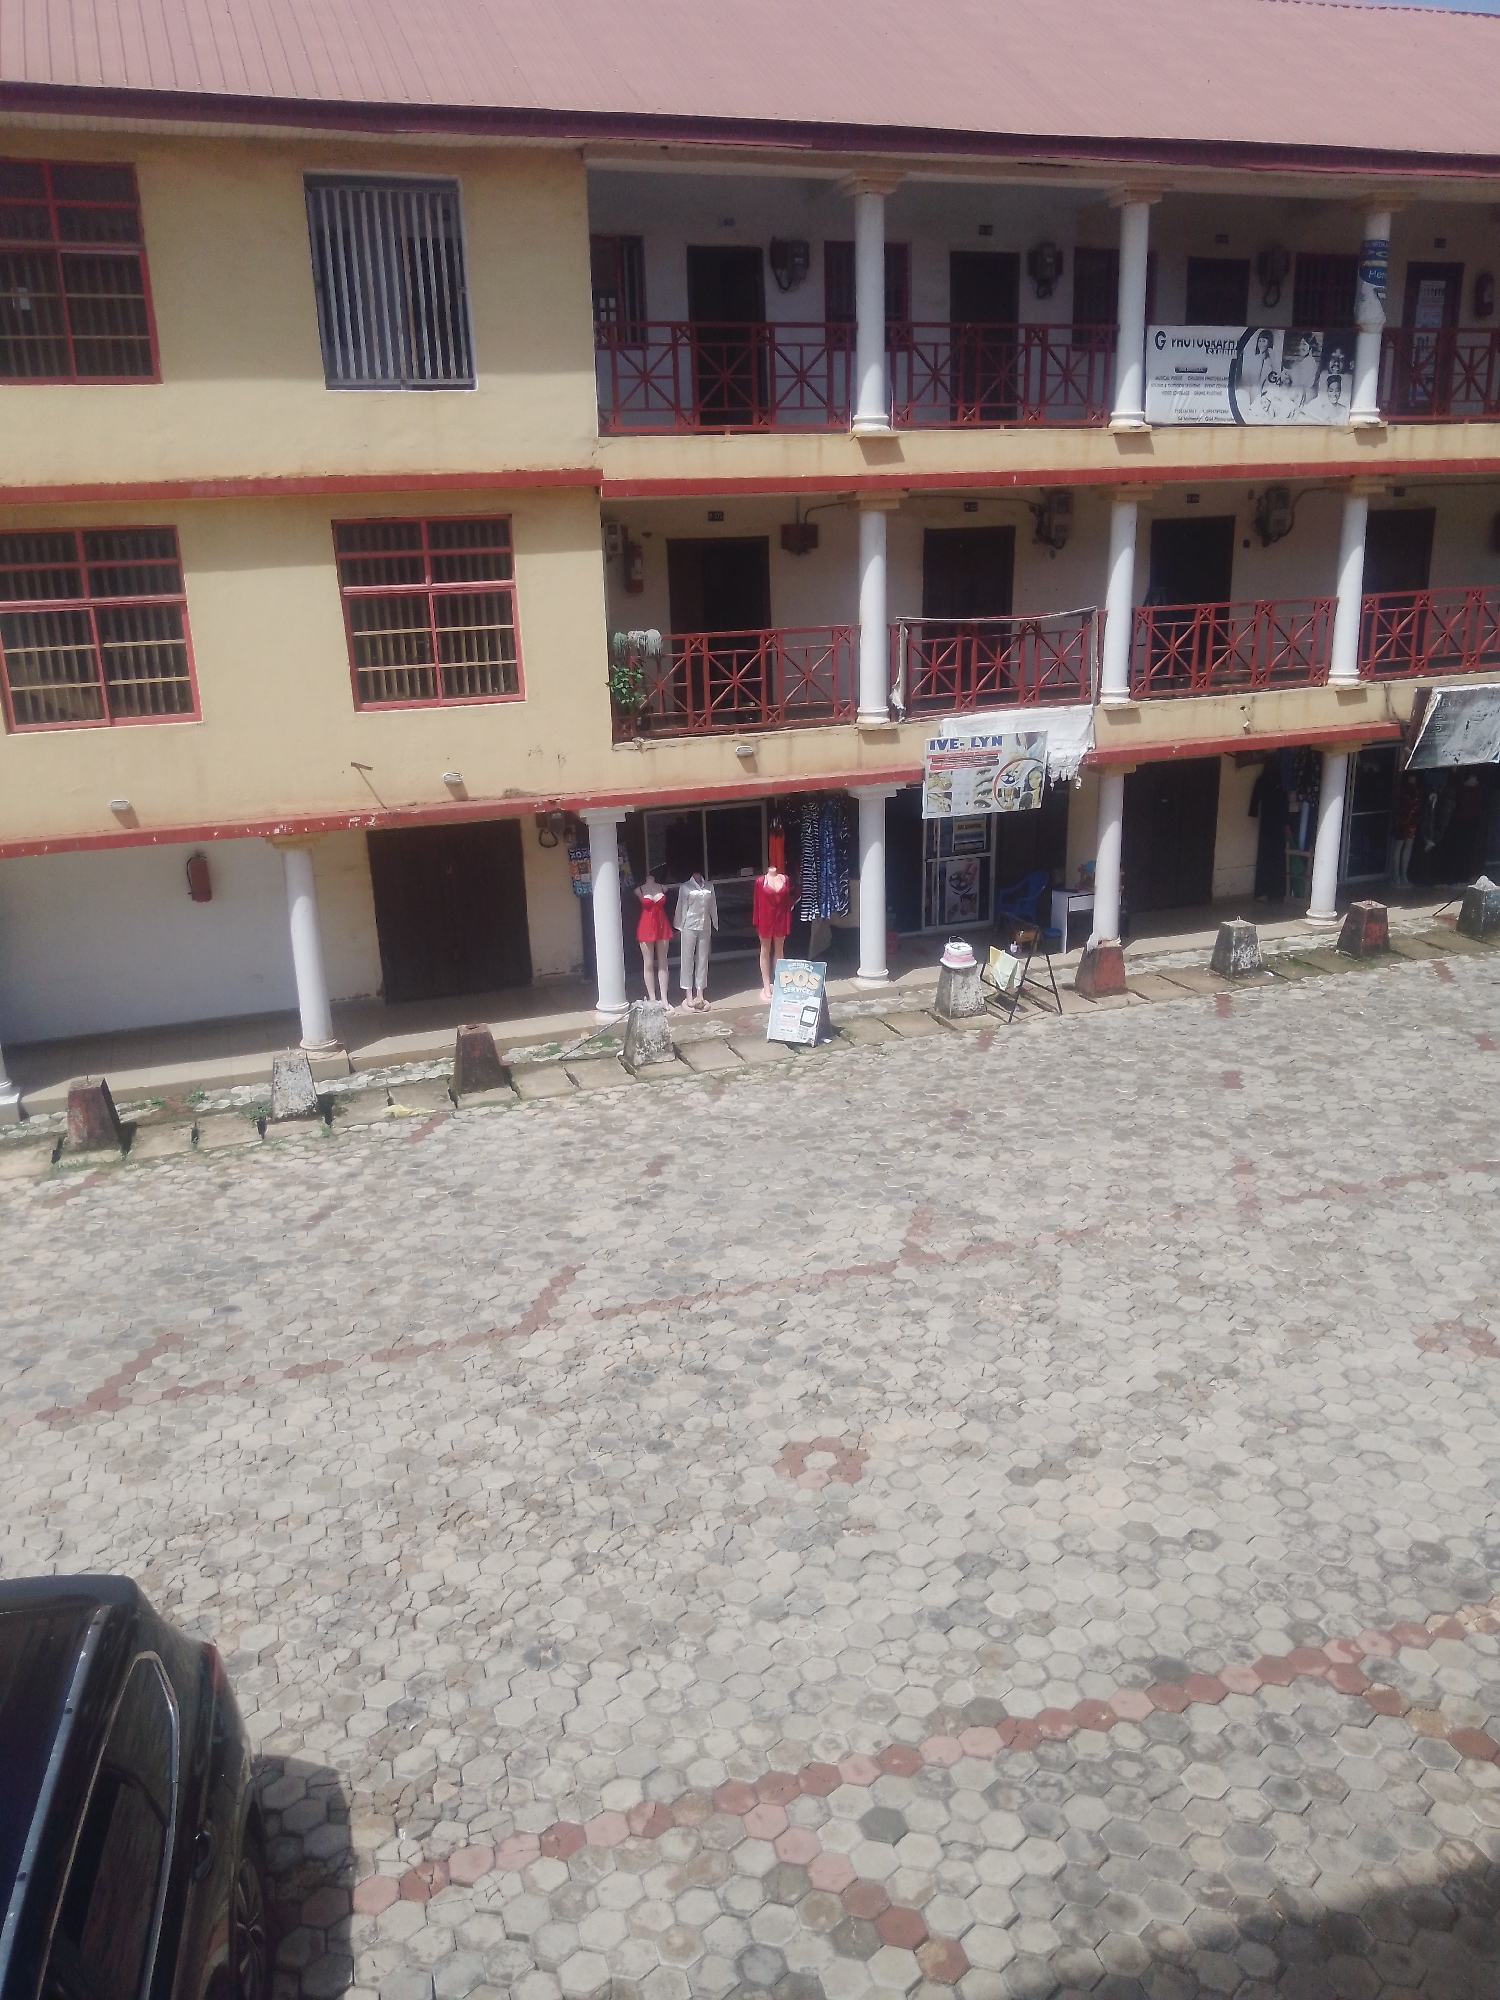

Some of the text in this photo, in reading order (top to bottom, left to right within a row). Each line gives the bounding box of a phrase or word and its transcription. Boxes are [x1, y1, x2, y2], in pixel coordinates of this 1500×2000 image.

[1154, 330, 1167, 351] G
[929, 735, 1003, 751] IVE- LYN
[779, 970, 821, 990] POS
